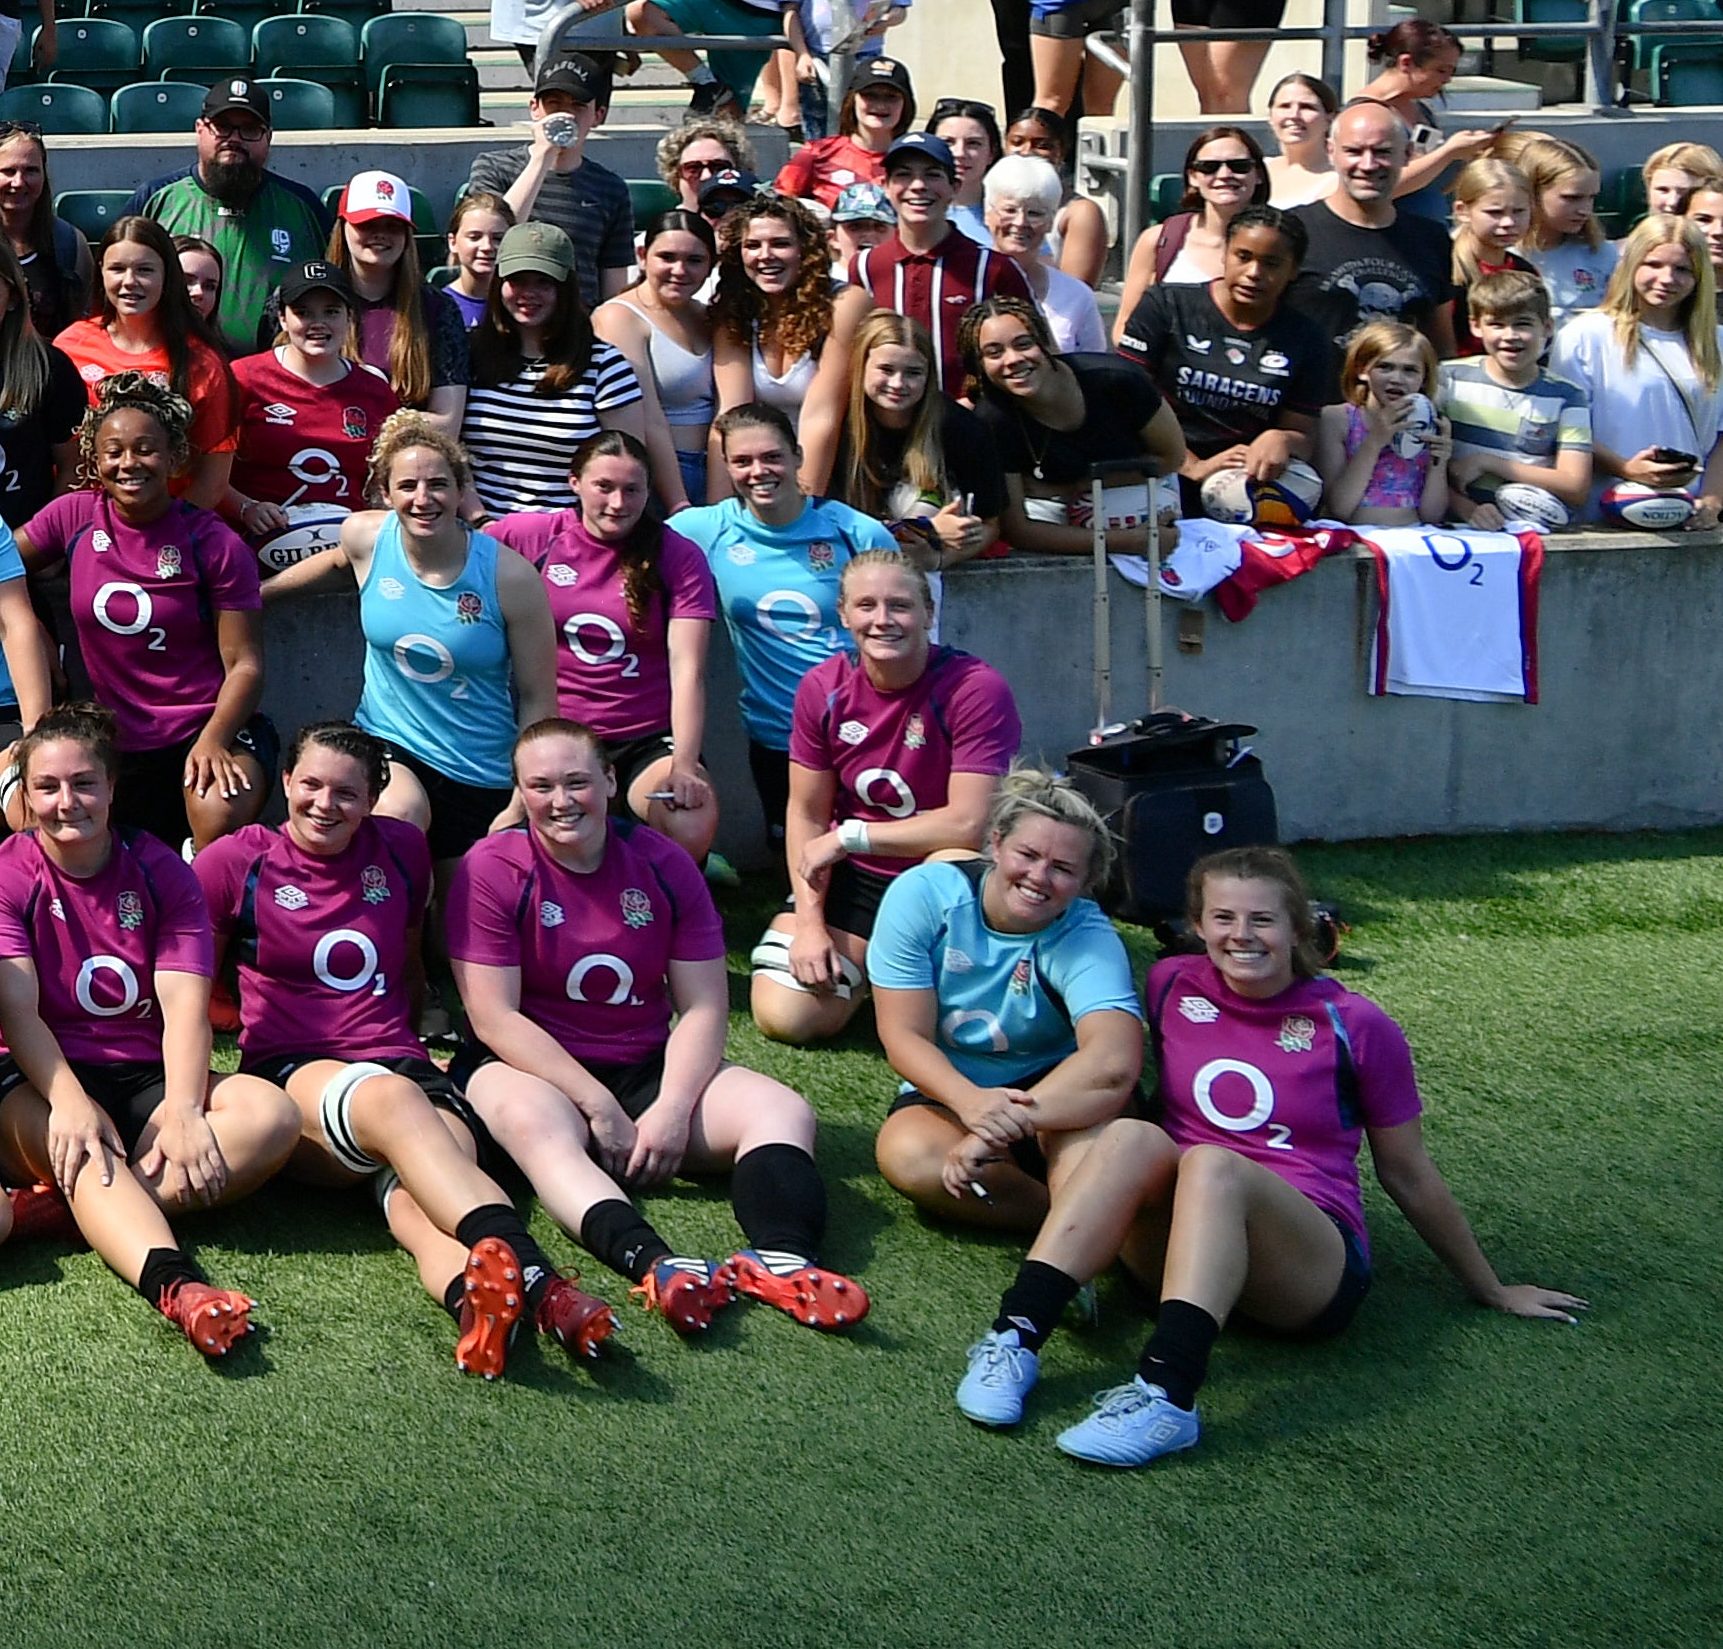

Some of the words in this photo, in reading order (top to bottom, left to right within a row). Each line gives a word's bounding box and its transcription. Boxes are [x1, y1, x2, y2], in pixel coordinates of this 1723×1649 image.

[1176, 365, 1282, 407] SARACENS
[286, 446, 348, 497] O2
[1423, 534, 1486, 588] O2
[92, 581, 167, 652] O2
[561, 611, 637, 676] O2
[754, 589, 837, 647] O2
[393, 633, 473, 704] O2
[75, 955, 154, 1021] O2
[313, 927, 383, 994] O2
[1192, 1058, 1291, 1151] O2
